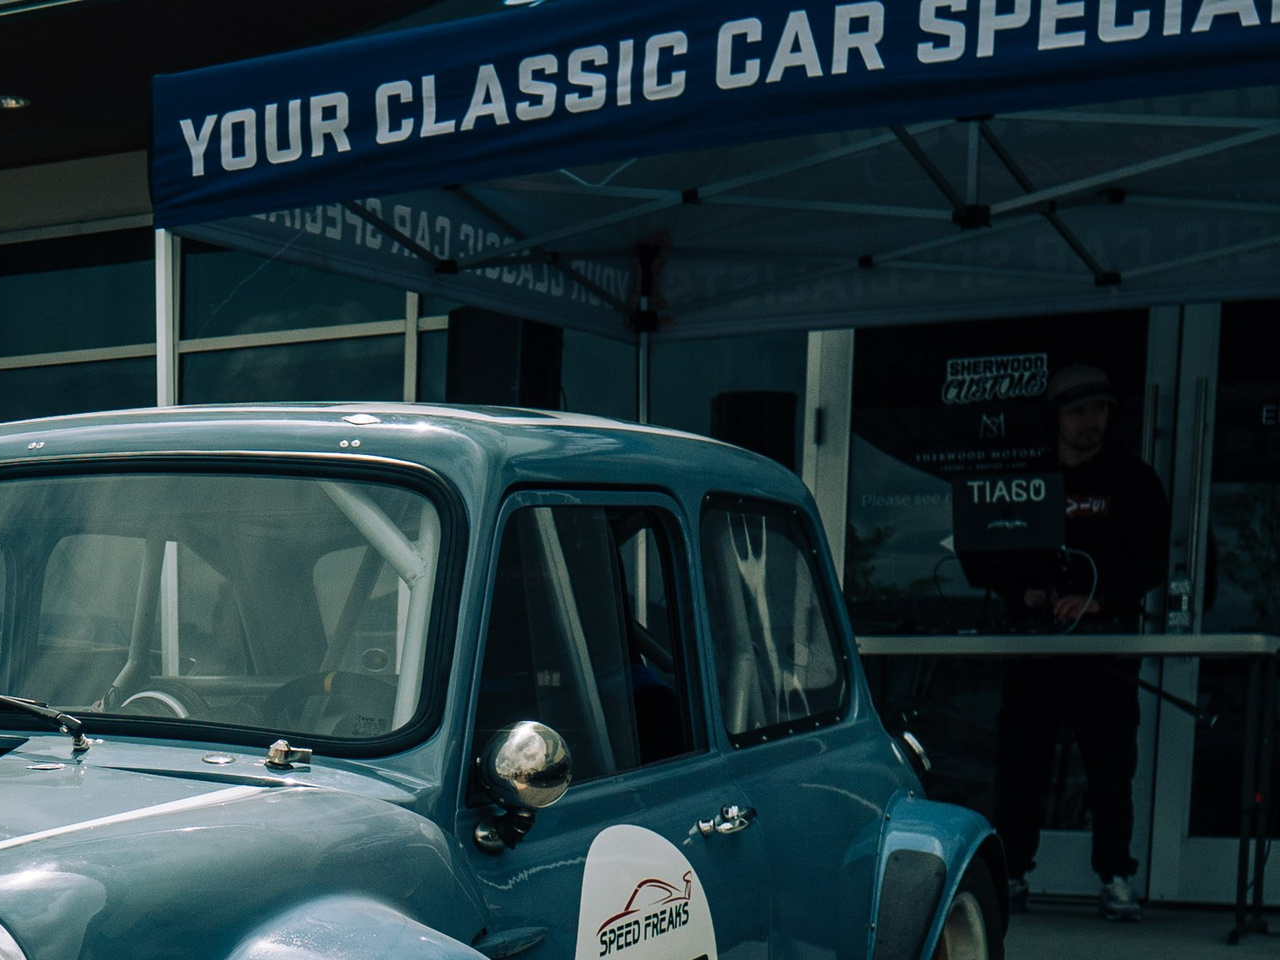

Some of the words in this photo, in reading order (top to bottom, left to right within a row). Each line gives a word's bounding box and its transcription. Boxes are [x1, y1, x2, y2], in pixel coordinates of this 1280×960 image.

[179, 91, 352, 178] YOUR
[375, 30, 688, 145] CLASSIC
[716, 1, 885, 90] CAR
[917, 0, 1280, 64] SPECI
[949, 355, 1046, 377] SHERWOOD
[1262, 403, 1280, 425] E
[599, 919, 641, 957] SPEED
[644, 901, 690, 940] FREAKS
